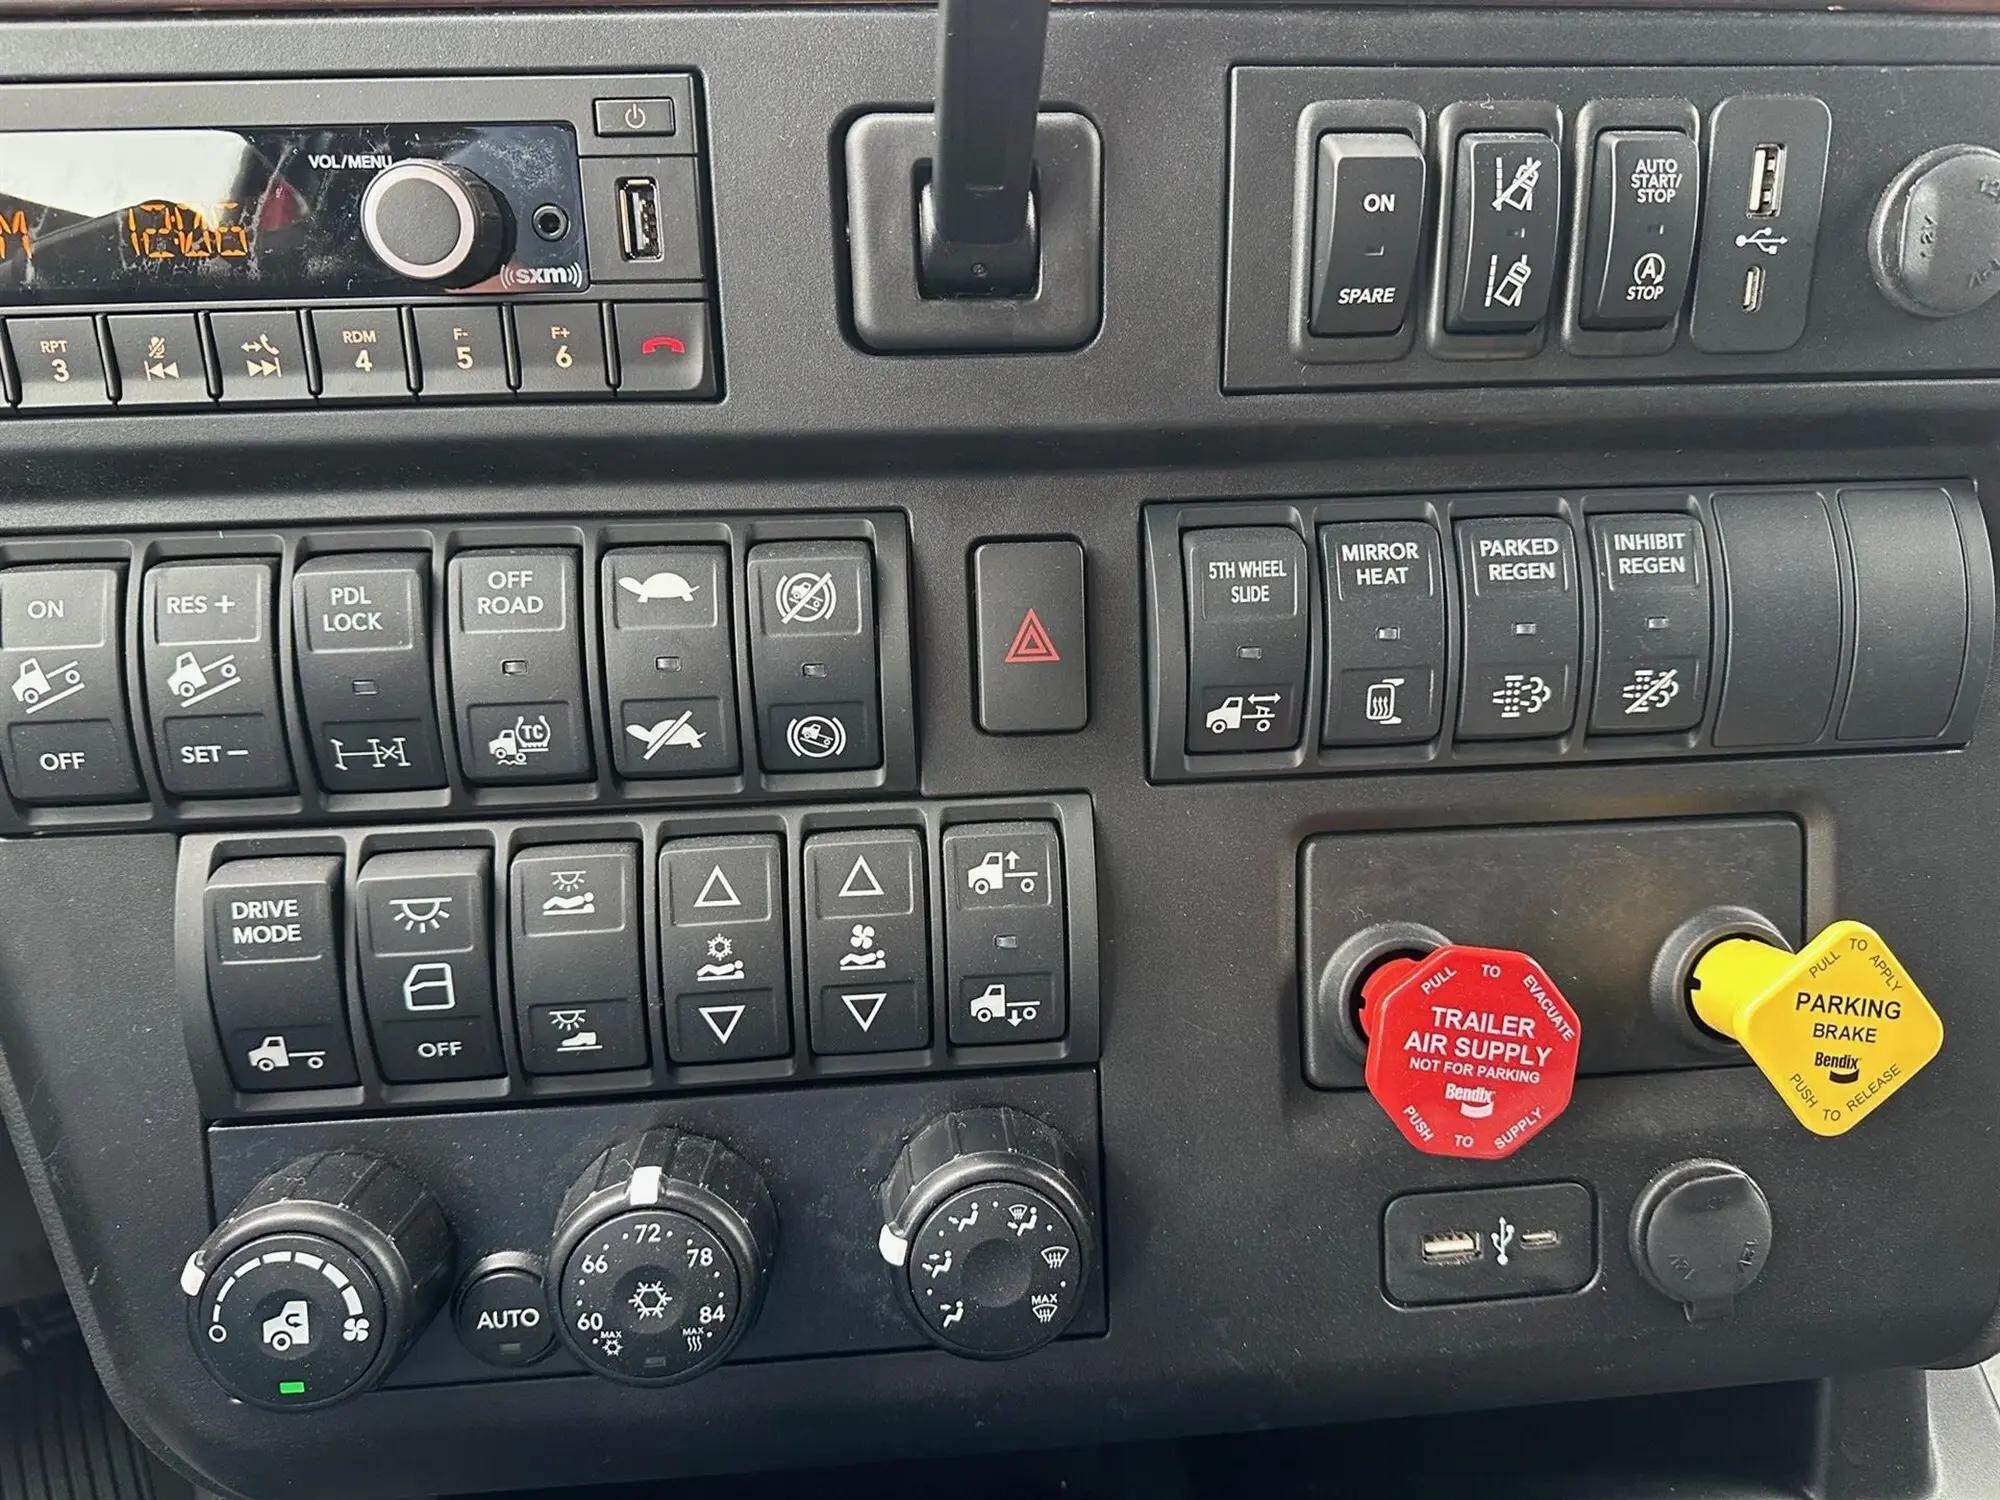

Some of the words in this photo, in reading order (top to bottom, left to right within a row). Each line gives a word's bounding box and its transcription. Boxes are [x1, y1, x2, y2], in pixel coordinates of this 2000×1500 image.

[308, 154, 393, 170] VOL/MENU
[1635, 158, 1678, 174] AUTO
[1630, 173, 1683, 189] START/
[1362, 193, 1396, 213] ON
[1636, 188, 1677, 203] STOP
[514, 266, 568, 285] sxm
[1338, 287, 1396, 305] SPARE
[1626, 285, 1665, 301] STOP
[342, 330, 377, 344] RDM
[551, 327, 571, 340] F+
[40, 340, 68, 353] RPT
[355, 350, 373, 372] 4
[456, 347, 474, 370] 5
[555, 345, 573, 369] 6
[51, 358, 71, 383] 3
[1479, 538, 1559, 557] PARKED
[1613, 532, 1686, 551] INHIBIT
[1341, 542, 1419, 562] MIRROR
[1208, 561, 1236, 580] 5TH
[1239, 559, 1287, 579] WHEEL
[1488, 561, 1556, 581] REGEN
[1618, 556, 1686, 575] REGEN
[487, 570, 533, 589] OFF
[1356, 567, 1409, 586] HEAT
[330, 586, 372, 606] PDL
[1231, 585, 1270, 603] SLIDE
[27, 600, 64, 619] ON
[167, 596, 208, 614] RES
[477, 596, 544, 615] ROAD
[322, 612, 384, 632] LOCK
[39, 752, 86, 771] OFF
[180, 745, 222, 764] SET
[231, 899, 300, 920] DRIVE
[233, 924, 302, 945] MODE
[1808, 951, 1841, 979] PULL
[1849, 938, 1868, 951] TO
[1869, 954, 1903, 992] APPLY
[1420, 965, 1458, 995] PULL
[1481, 964, 1502, 978] TO
[1522, 974, 1576, 1042] EVACUATE
[1795, 992, 1902, 1020] PARKING
[1431, 1006, 1537, 1039] TRAILER
[1812, 1023, 1878, 1044] BRAKE
[417, 1041, 463, 1058] OFF
[1403, 1031, 1449, 1057] AIR
[1454, 1036, 1553, 1068] SUPPLY
[1814, 1051, 1860, 1070] Bendix
[1409, 1057, 1441, 1073] NOT
[1443, 1061, 1474, 1078] FOR
[1477, 1065, 1541, 1085] PARKING
[1444, 1083, 1495, 1104] Bendix
[1790, 1073, 1819, 1108] PUSH
[1822, 1108, 1842, 1122] TO
[1846, 1063, 1903, 1112] RELEASE
[1402, 1104, 1436, 1143] PUSH
[1454, 1134, 1475, 1149] TO
[1493, 1105, 1545, 1151] SUPPLY
[634, 1223, 661, 1244] 72
[581, 1254, 609, 1274] 66
[687, 1247, 714, 1269] 78
[1031, 1294, 1058, 1305] MAX
[476, 1307, 541, 1330] AUTO
[577, 1312, 604, 1332] 60
[699, 1304, 726, 1325] 84
[600, 1330, 622, 1340] MAX
[682, 1327, 705, 1337] MAX
